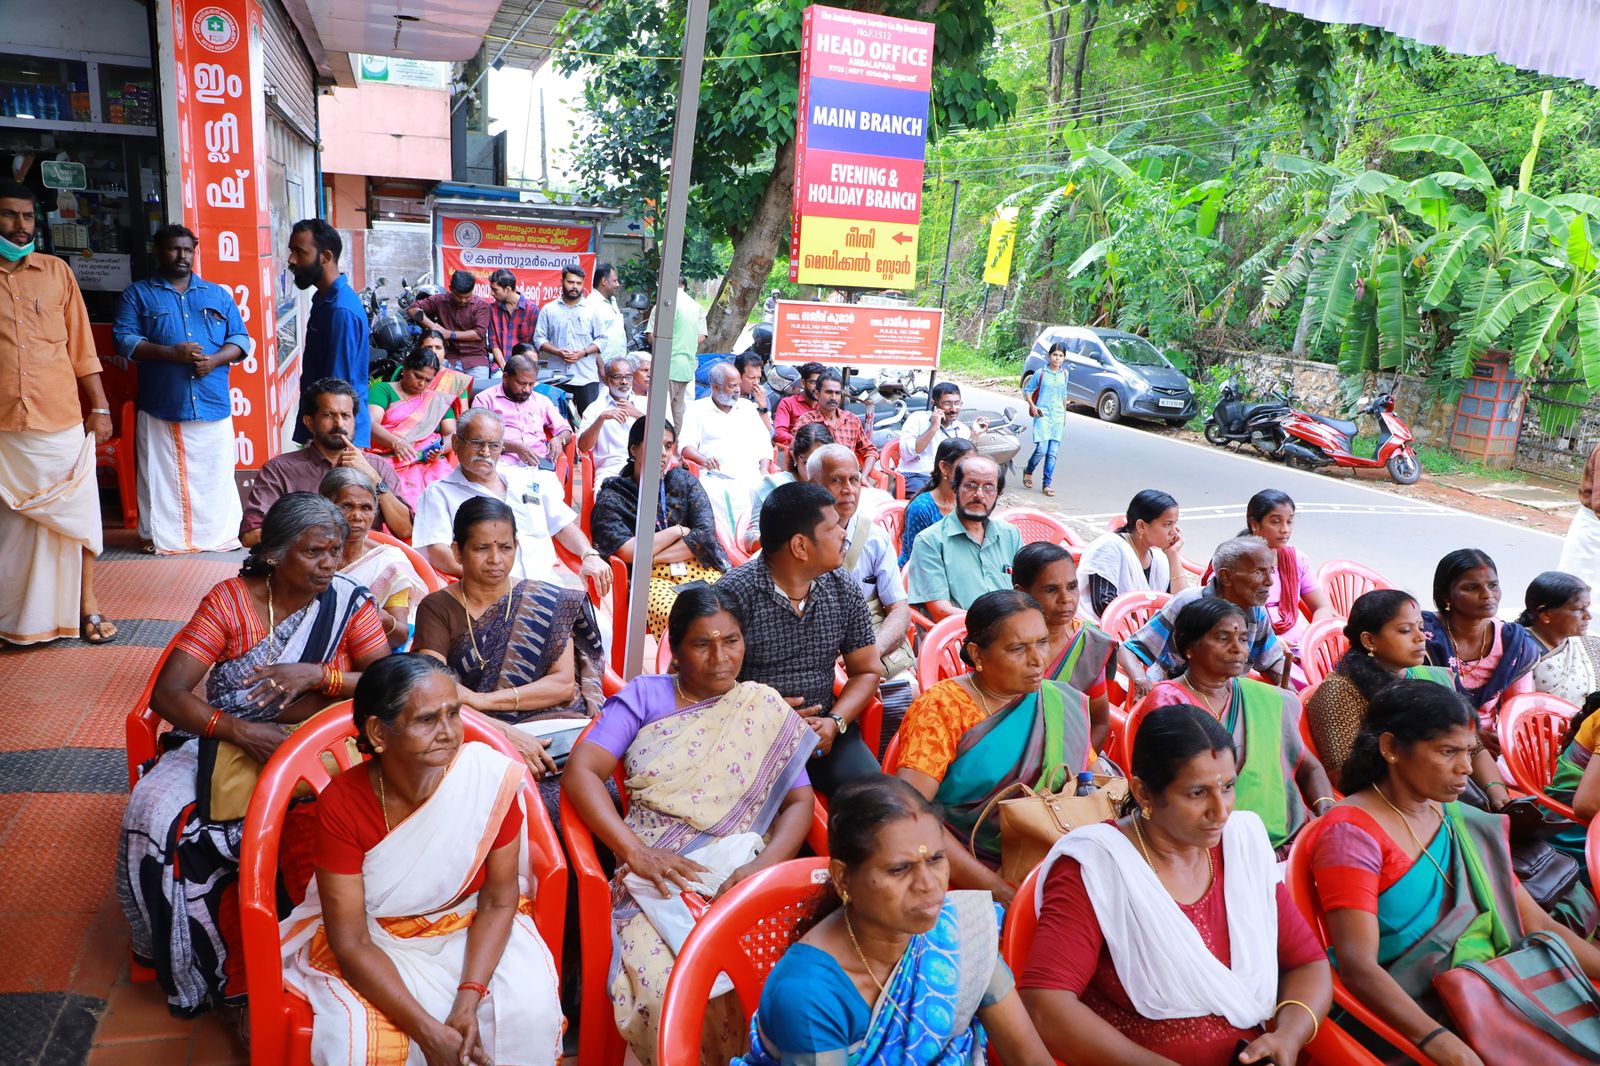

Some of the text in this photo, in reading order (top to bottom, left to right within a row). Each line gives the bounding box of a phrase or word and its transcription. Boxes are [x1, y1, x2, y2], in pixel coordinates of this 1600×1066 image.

[857, 28, 892, 40] No.F.1512
[816, 33, 928, 66] HEAD OFFICE
[848, 58, 896, 71] AMBALAPARA
[813, 105, 923, 136] MAIN BRANCH
[831, 163, 898, 187] EVENING &
[808, 183, 916, 210] HOLIDAY BRANCH
[845, 226, 875, 248] നീതി
[805, 250, 911, 280] മെഡിക്കൽ സ്റ്റോർ
